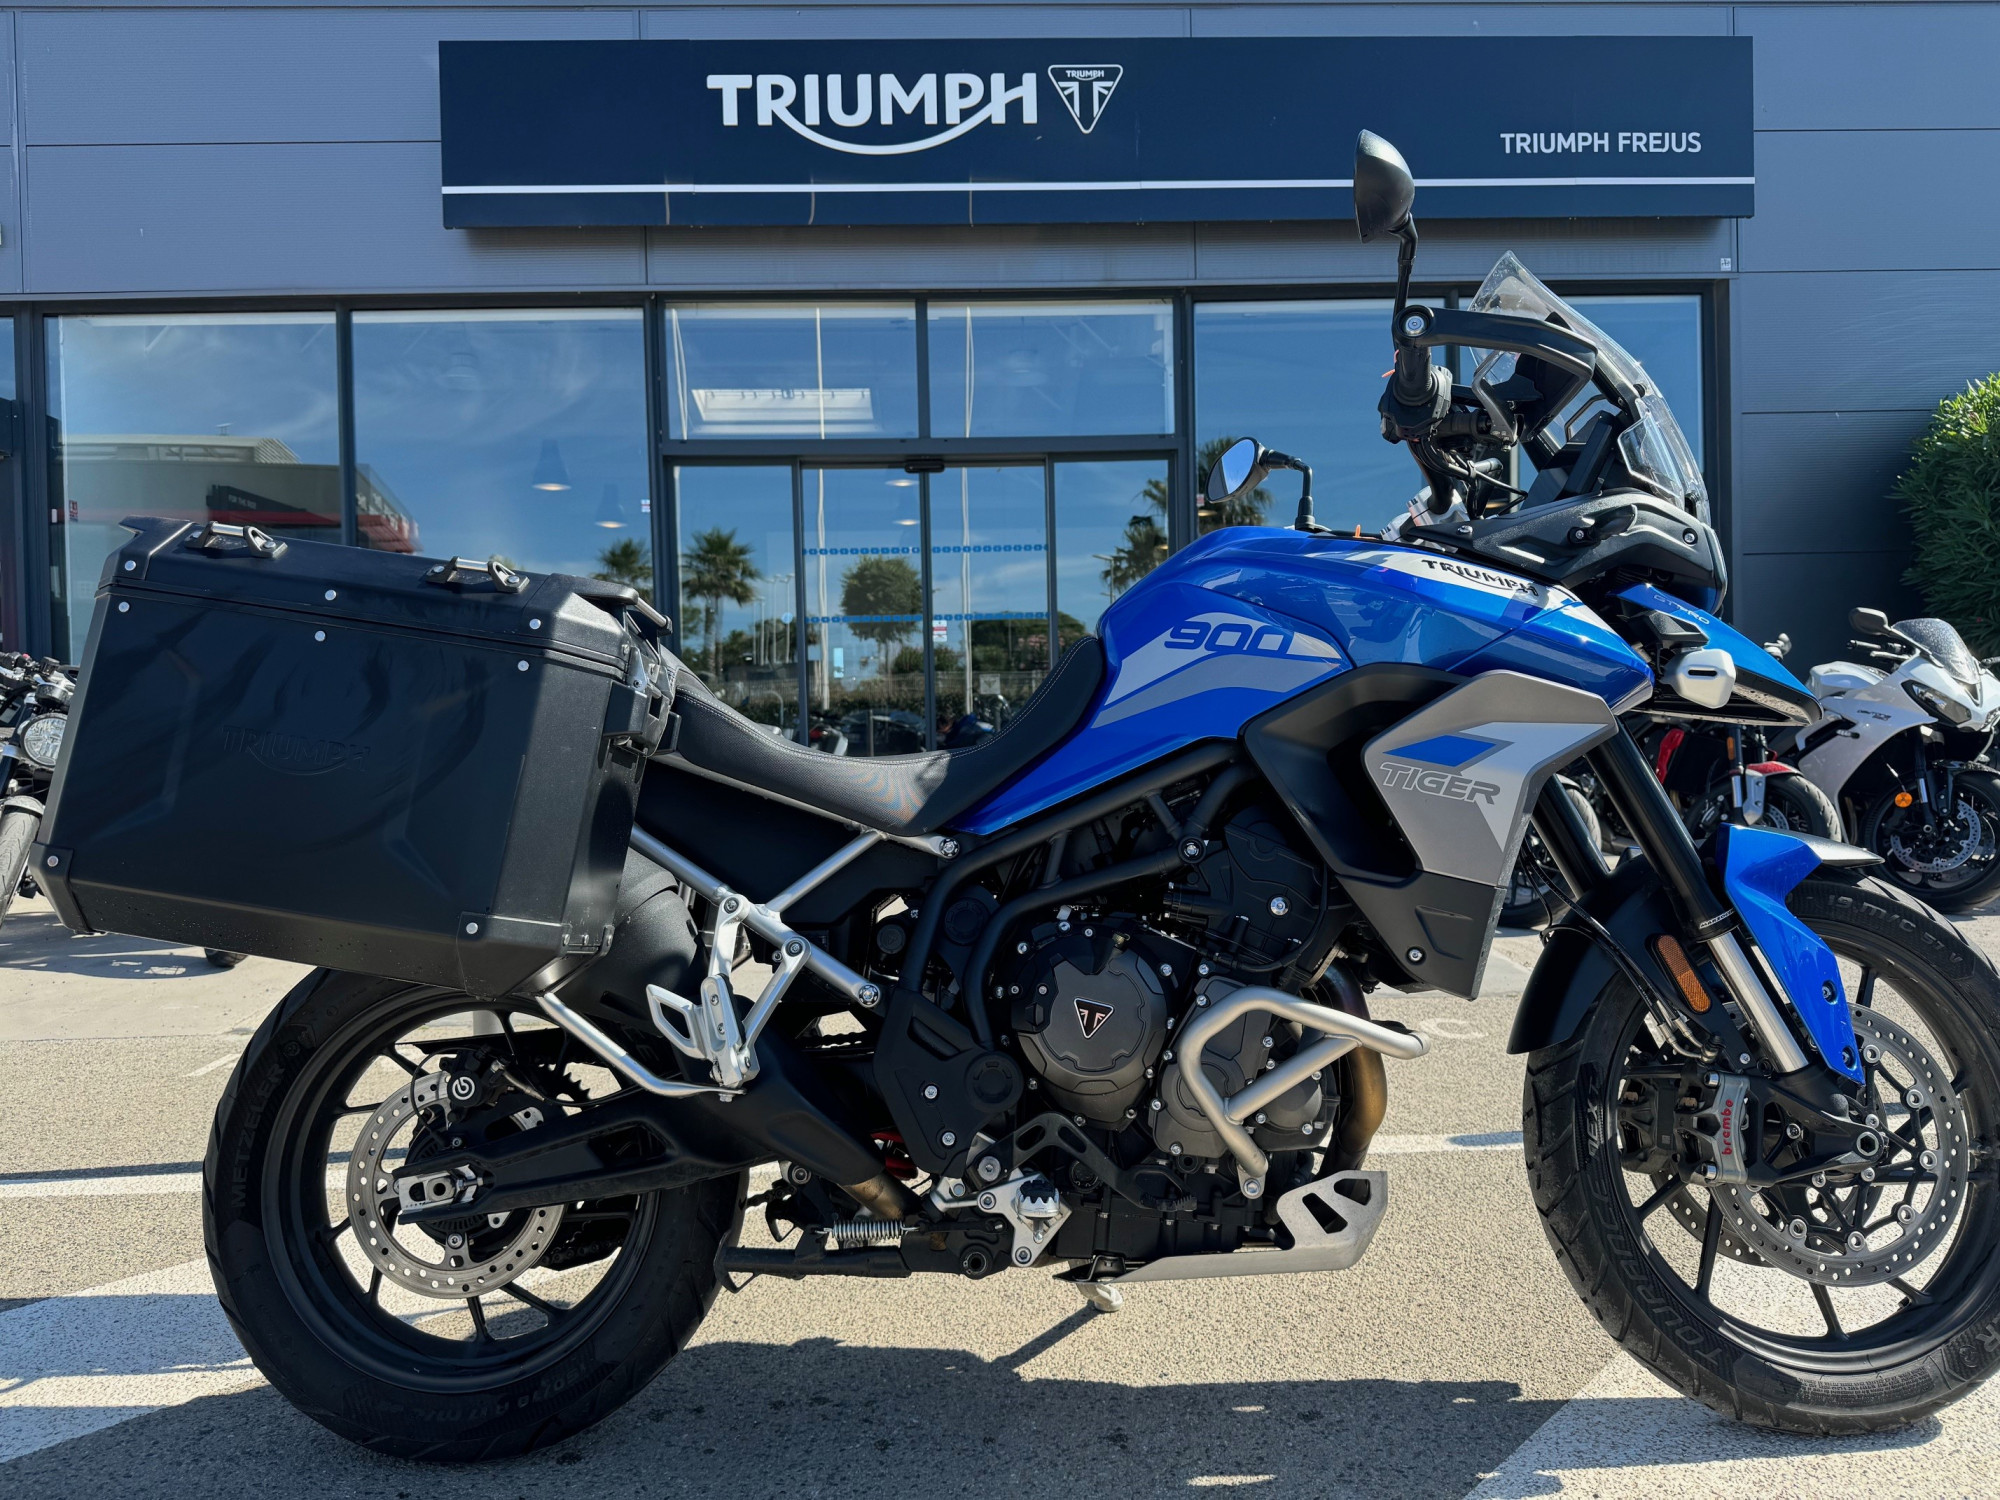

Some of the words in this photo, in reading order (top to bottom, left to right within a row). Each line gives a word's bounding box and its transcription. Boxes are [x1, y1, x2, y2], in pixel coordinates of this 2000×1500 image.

[1065, 69, 1105, 81] TRIUMPH
[706, 73, 1038, 155] TRIUMPH
[1500, 132, 1609, 154] TRIUMPH
[1618, 132, 1702, 153] FREJUS
[1421, 559, 1539, 597] TRIUMPH
[1164, 620, 1294, 655] 900
[218, 723, 372, 777] TRIUMPH
[1380, 761, 1501, 805] TIGER
[1721, 1098, 1735, 1156] brembo
[1587, 1174, 1722, 1368] TOURANCE
